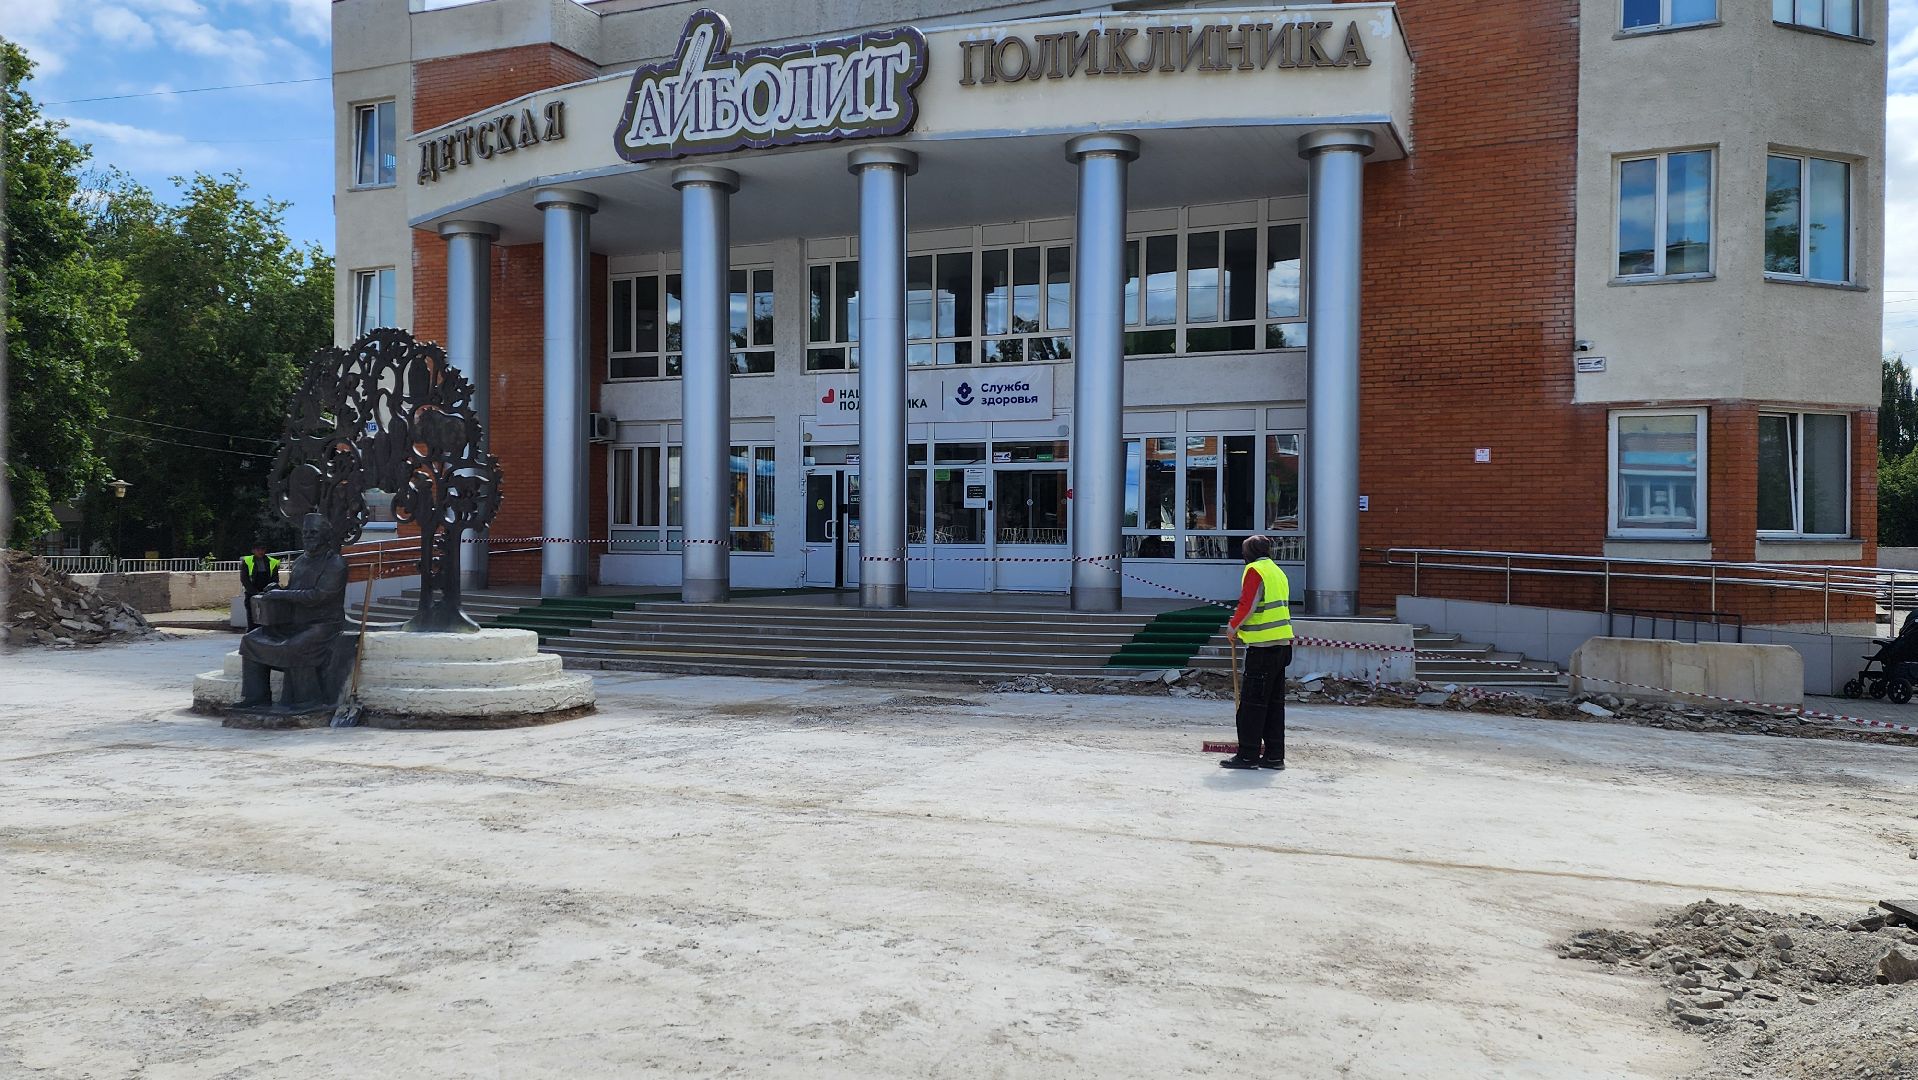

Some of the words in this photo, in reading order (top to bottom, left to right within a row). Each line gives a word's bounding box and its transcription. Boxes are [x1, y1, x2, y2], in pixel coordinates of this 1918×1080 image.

[417, 101, 564, 185] ДЕТСКАЯ
[630, 31, 903, 140] АЙБОЛИТ
[958, 20, 1371, 86] ПОЛИКЛИНИКА
[981, 381, 1030, 394] Служба
[981, 395, 1038, 406] здоровья
